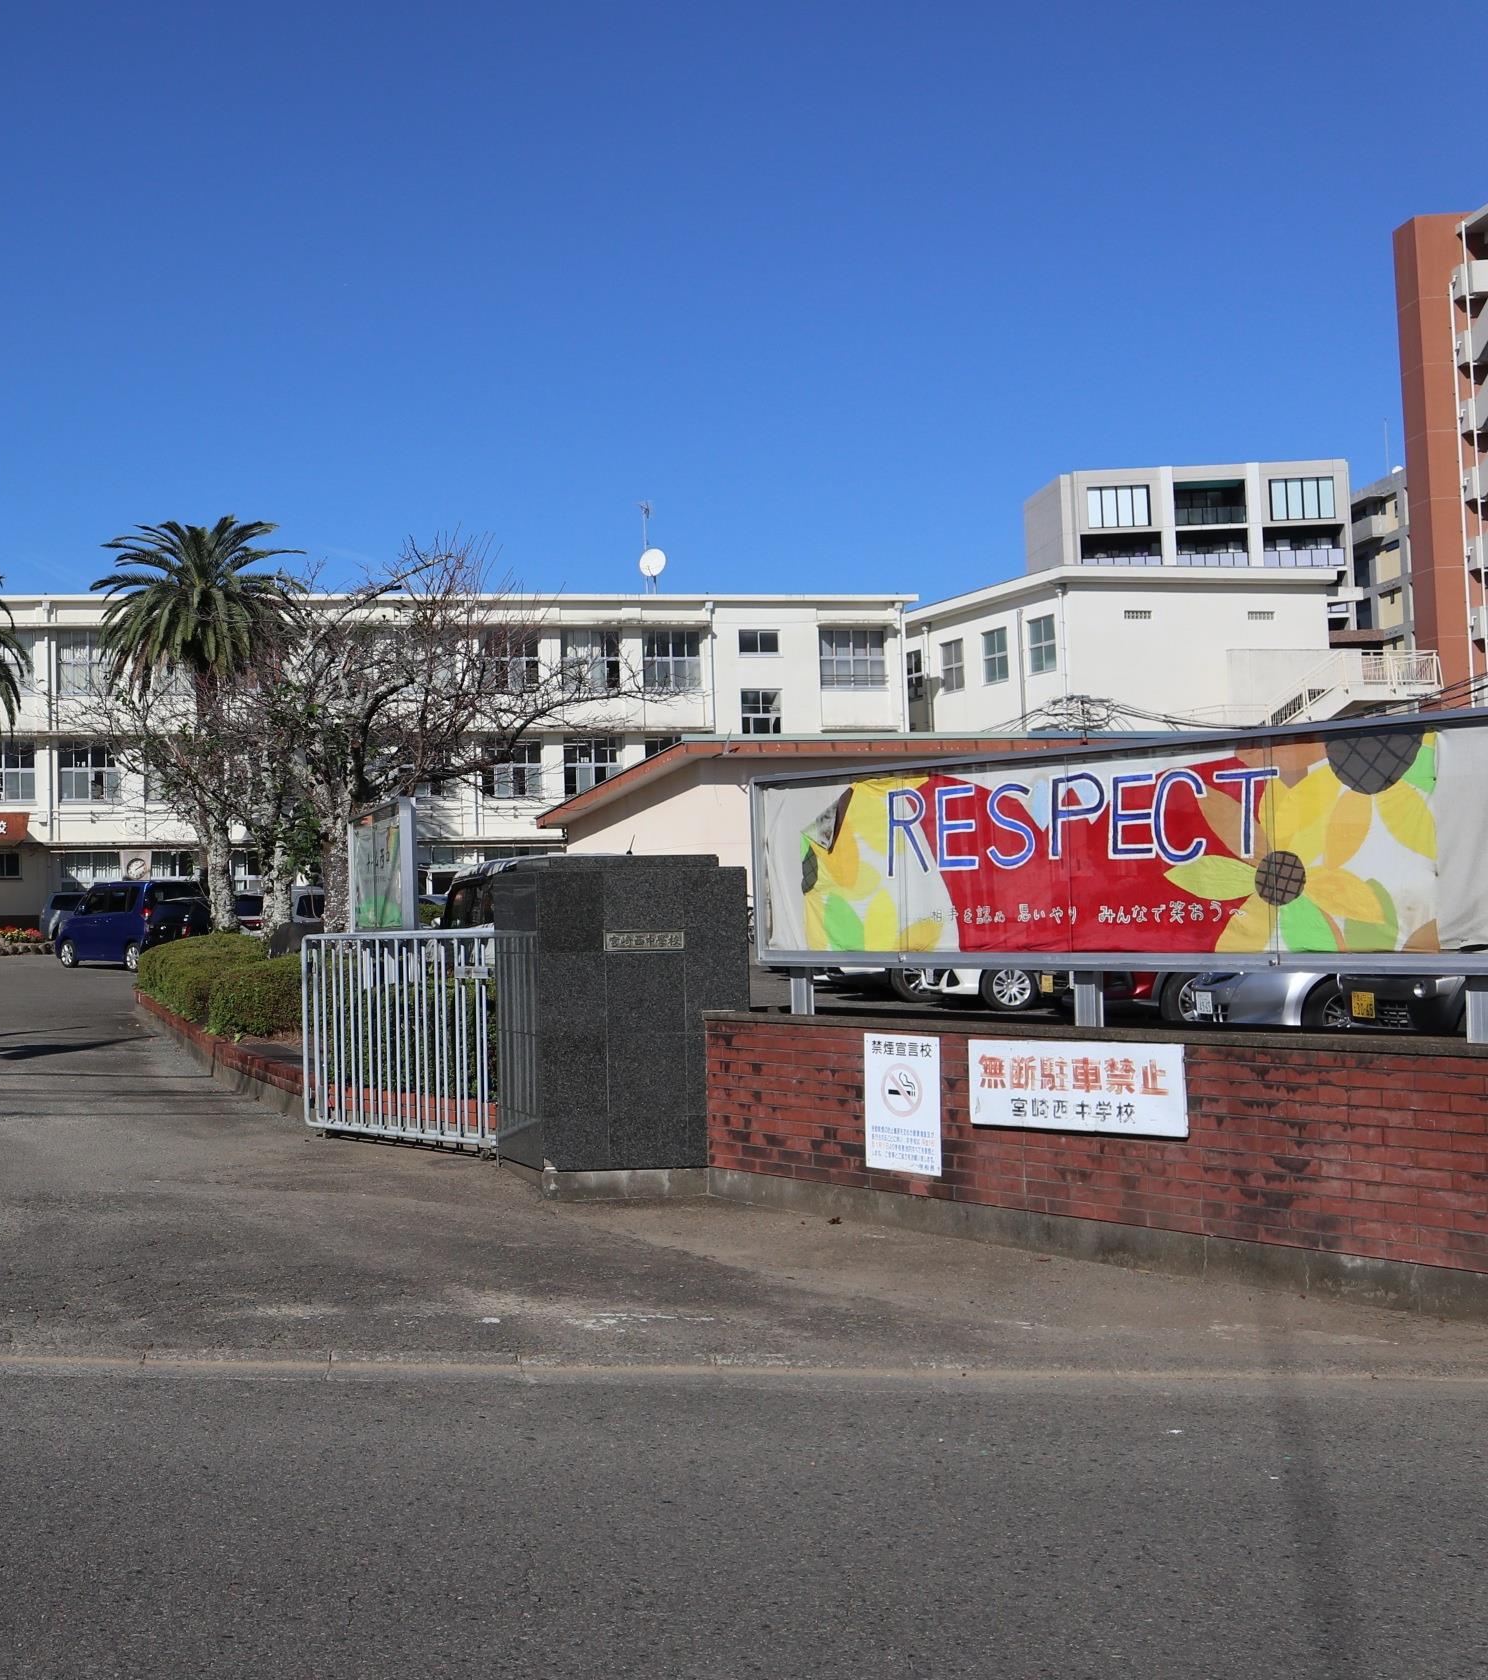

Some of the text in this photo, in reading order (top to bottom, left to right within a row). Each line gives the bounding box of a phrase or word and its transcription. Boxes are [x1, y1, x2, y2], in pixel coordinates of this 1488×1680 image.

[887, 767, 1279, 878] RESPECT
[1018, 903, 1077, 925] 思いやり
[871, 1040, 932, 1058] 禁煙宣言校
[978, 1054, 1169, 1096] 無断駐車禁止
[1011, 1097, 1135, 1124] 宮崎西中学校
